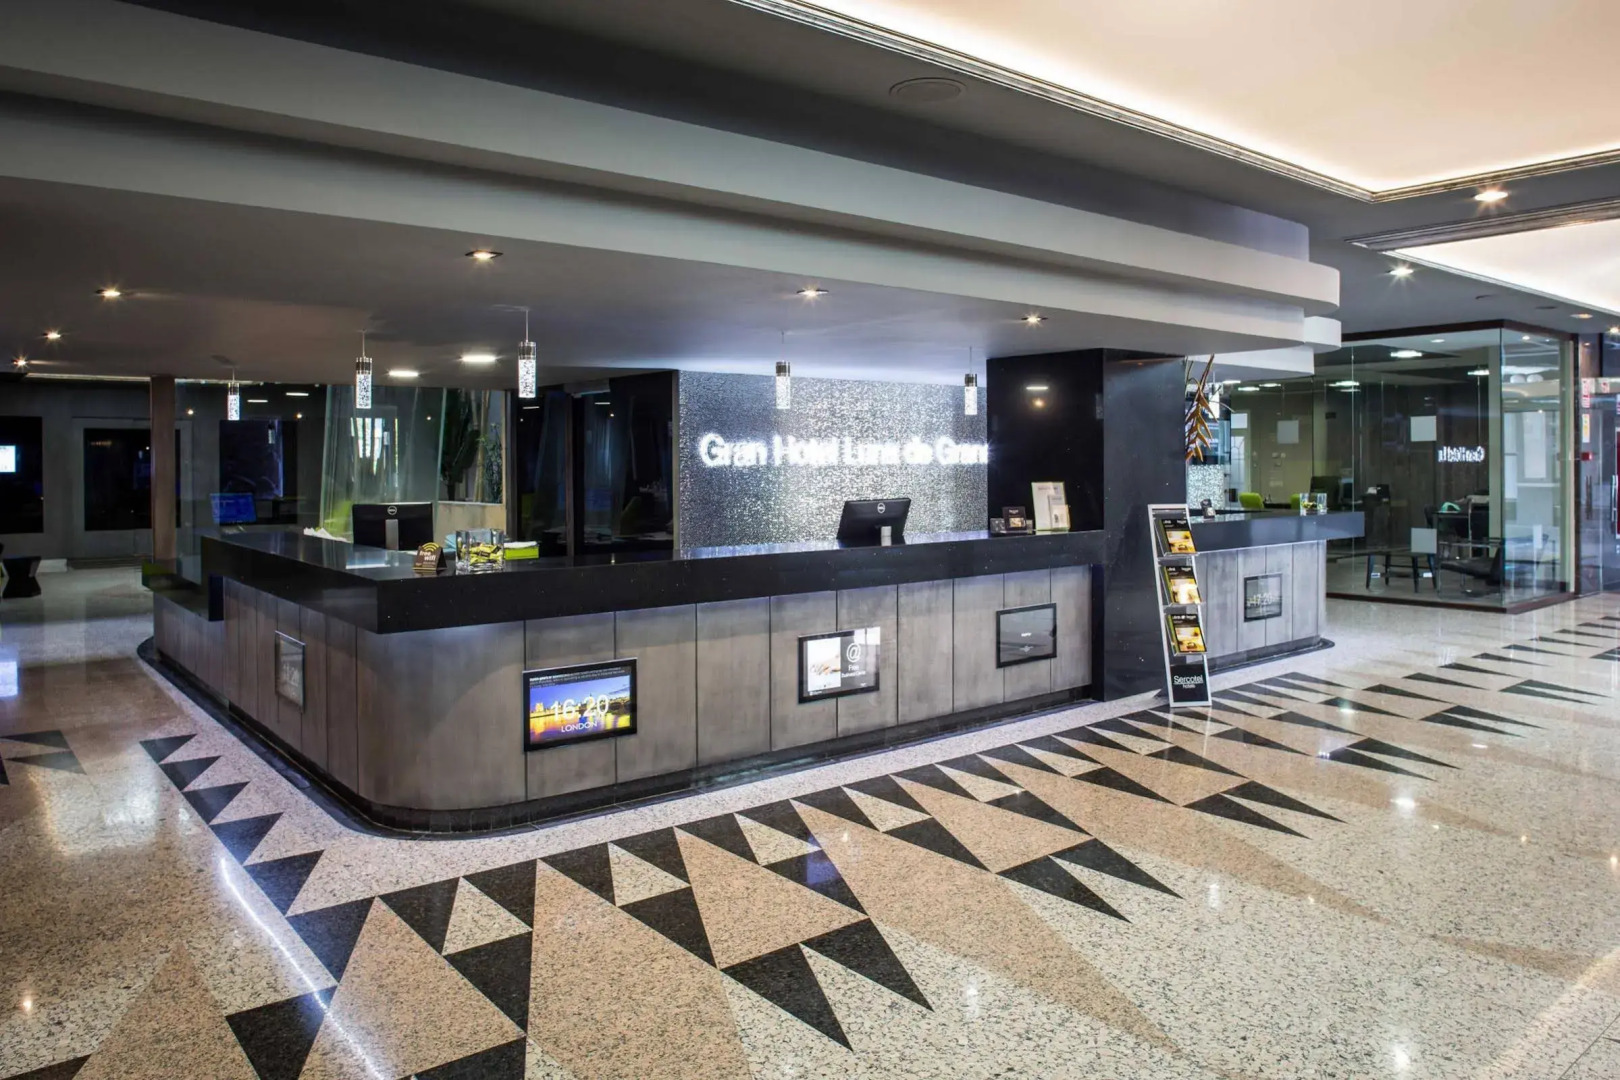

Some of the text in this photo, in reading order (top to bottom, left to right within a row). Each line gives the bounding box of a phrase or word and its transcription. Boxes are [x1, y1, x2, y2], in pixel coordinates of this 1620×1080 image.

[699, 433, 767, 466] Gran
[773, 434, 838, 466] Hotel
[846, 643, 861, 662] @
[1173, 674, 1204, 684] Sercotel
[551, 694, 609, 722] 16:20
[561, 721, 598, 732] LONDON
